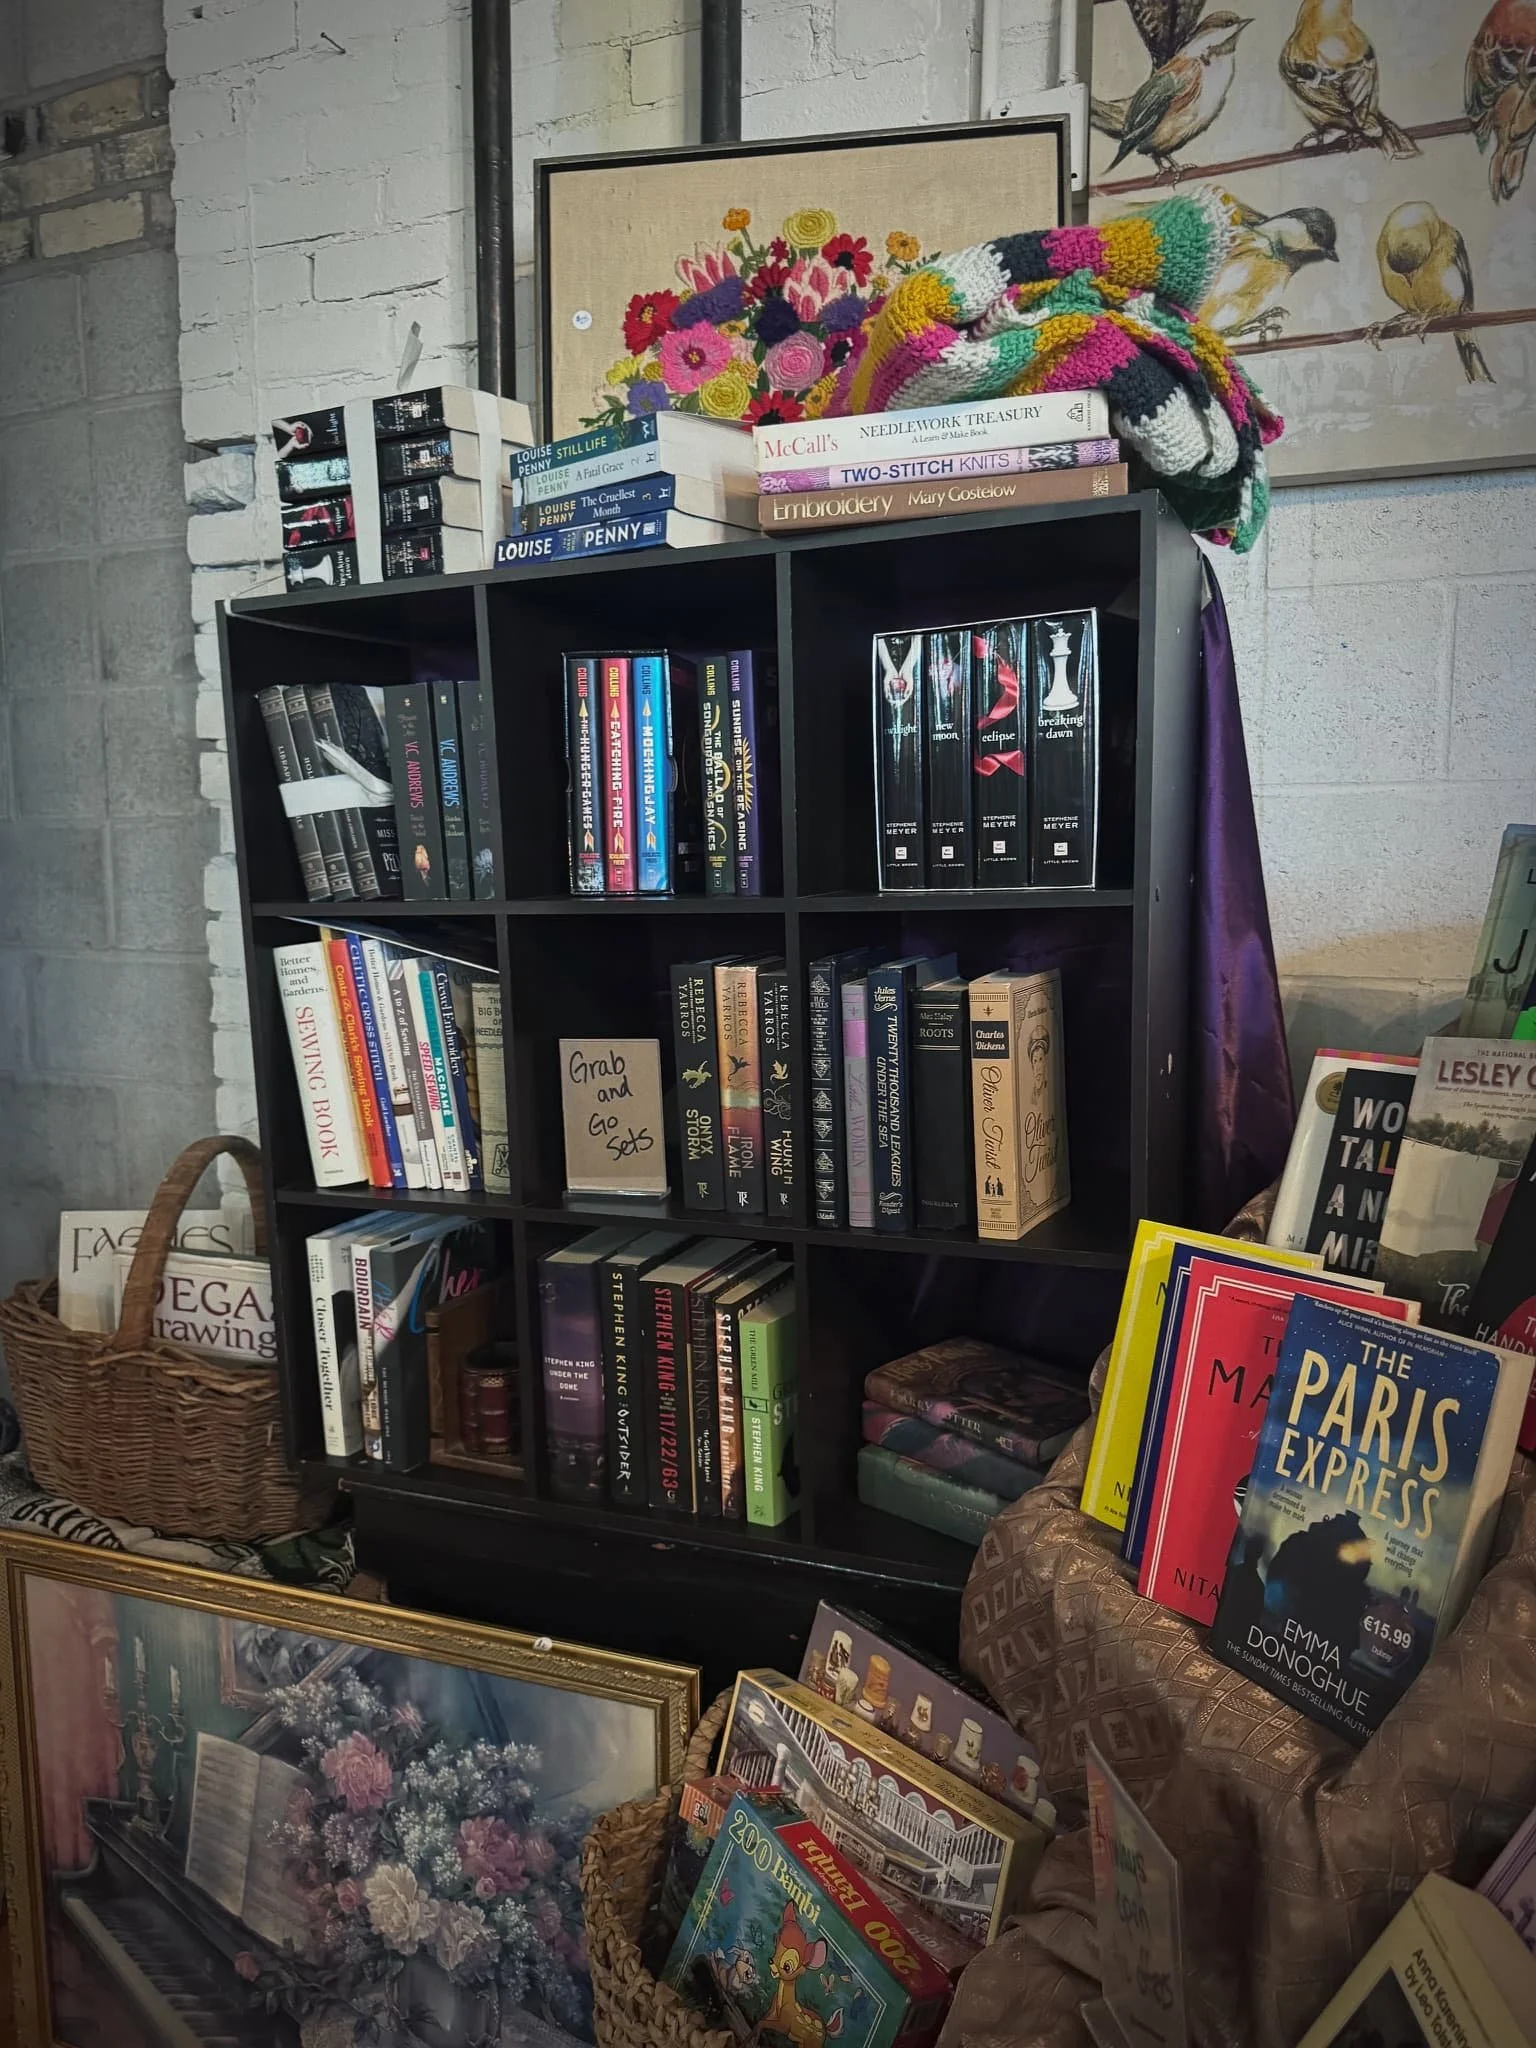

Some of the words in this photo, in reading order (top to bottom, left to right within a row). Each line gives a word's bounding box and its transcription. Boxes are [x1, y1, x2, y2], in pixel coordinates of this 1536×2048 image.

[860, 415, 961, 440] NEEDLEWORK
[964, 405, 1043, 426] TREASURY
[517, 445, 552, 464] LOUISE
[556, 445, 584, 460] STILL
[586, 436, 607, 452] LIFE
[764, 433, 839, 459] McCall's
[518, 458, 551, 477] PENNY
[536, 468, 570, 485] LOUISE
[603, 461, 624, 475] Grace
[841, 459, 954, 483] TWO-STITCH
[959, 453, 1010, 472] KNITS
[537, 480, 569, 496] PENNY
[581, 495, 598, 508] The
[599, 489, 636, 506] Cruellest
[773, 492, 894, 521] Embroidery
[908, 489, 947, 507] Mary
[948, 483, 1017, 502] Gostelow
[538, 500, 577, 516] LOUISE
[540, 512, 574, 527] PENNY
[593, 504, 621, 519] Month
[498, 538, 552, 562] LOUISE
[584, 521, 641, 548] PENNY
[577, 667, 588, 697] COLLINS
[609, 667, 620, 697] COLLINS
[706, 664, 716, 696] COLLINS
[932, 731, 960, 742] moon
[936, 722, 954, 731] new
[981, 731, 1016, 748] eclipse
[1038, 714, 1083, 729] breaking
[1045, 729, 1074, 739] dawn
[610, 721, 622, 791] CATCHING
[642, 726, 656, 824] MOCKINGJAY
[406, 760, 424, 808] ANDREWS
[441, 759, 460, 807] ANDREWS
[732, 700, 742, 755] SUNRISE
[737, 795, 747, 851] REAPING
[582, 791, 593, 829] GAMES
[612, 797, 624, 828] FIRE
[707, 798, 716, 852] SNAKES
[983, 821, 1017, 829] MEYER
[280, 956, 311, 967] Better
[290, 976, 308, 986] and
[436, 973, 452, 1009] Crewel
[350, 944, 367, 997] CELTIC
[361, 1002, 375, 1038] CROSS
[368, 1041, 384, 1081] STITCH
[678, 984, 691, 1038] YARROS
[693, 978, 708, 1043] REBECCA
[722, 987, 733, 1042] YARROS
[737, 982, 748, 1047] REBECCA
[763, 990, 775, 1045] YARROS
[779, 984, 791, 1050] REBECCA
[335, 965, 348, 997] Coats
[353, 1055, 367, 1096] Sewing
[361, 1099, 375, 1128] Book
[401, 1027, 411, 1056] Sewing
[443, 1011, 461, 1077] Embroidery
[887, 1016, 899, 1066] TWENTY
[919, 1028, 955, 1038] ROOTS
[975, 1030, 1005, 1039] Charles
[975, 1041, 1006, 1051] Dickens
[419, 1042, 433, 1072] SPEED
[569, 1049, 626, 1084] Grab
[1437, 1060, 1521, 1088] LESLEY
[296, 1006, 326, 1091] SEWING
[312, 1099, 340, 1159] BOOK
[424, 1074, 440, 1111] SEWING
[597, 1075, 634, 1103] and
[876, 1056, 887, 1097] UNDER
[980, 1065, 1002, 1114] Oliver
[878, 1100, 888, 1124] THE
[888, 1068, 900, 1132] THOUSAND
[588, 1113, 619, 1136] Go
[686, 1109, 701, 1161] STORM
[699, 1115, 714, 1155] ONYX
[879, 1126, 889, 1149] SEA
[981, 1117, 1004, 1170] Twist
[727, 1126, 742, 1178] FLAME
[740, 1136, 755, 1170] IRON
[770, 1139, 784, 1176] WING
[891, 1135, 902, 1187] LEAGUES
[355, 1258, 372, 1331] BOURDAIN
[612, 1272, 625, 1347] STEPHEN
[1438, 1279, 1471, 1318] The
[315, 1296, 328, 1342] Closer
[654, 1287, 674, 1351] STEPHEN
[691, 1295, 709, 1371] STEPHEN
[1401, 1327, 1417, 1339] along
[575, 1359, 595, 1368] KING
[718, 1313, 733, 1385] STEPHEN
[1360, 1340, 1414, 1380] THE
[320, 1346, 334, 1411] Together
[549, 1370, 571, 1379] UNDER
[574, 1371, 589, 1380] THE
[559, 1382, 579, 1391] DOME
[616, 1354, 628, 1396] KING
[656, 1355, 676, 1392] KING
[695, 1379, 712, 1421] KING
[719, 1395, 735, 1433] KING
[1288, 1349, 1461, 1483] PARIS
[616, 1409, 632, 1480] OUTSIDER
[659, 1412, 680, 1489] 11/22/63
[751, 1417, 762, 1465] STEPHEN
[753, 1467, 764, 1492] KING
[1275, 1427, 1440, 1540] EXPRESS
[1283, 1618, 1341, 1670] EMMA
[1363, 1615, 1412, 1649] €15.99
[1225, 1640, 1241, 1656] THE
[1242, 1651, 1270, 1674] SUNDAY
[1269, 1666, 1292, 1687] TIMES
[1292, 1682, 1344, 1721] BESTSELLING
[1247, 1625, 1371, 1716] DONOGHUE
[728, 1809, 773, 1871] 200
[771, 1852, 821, 1926] Bambi
[797, 1835, 871, 1914] Bambi
[863, 1920, 922, 1975] 200
[1405, 1965, 1418, 1989] by
[1415, 1983, 1434, 2017] Leo
[1412, 1948, 1438, 1992] Anna
[1434, 1986, 1473, 2048] Karenin
